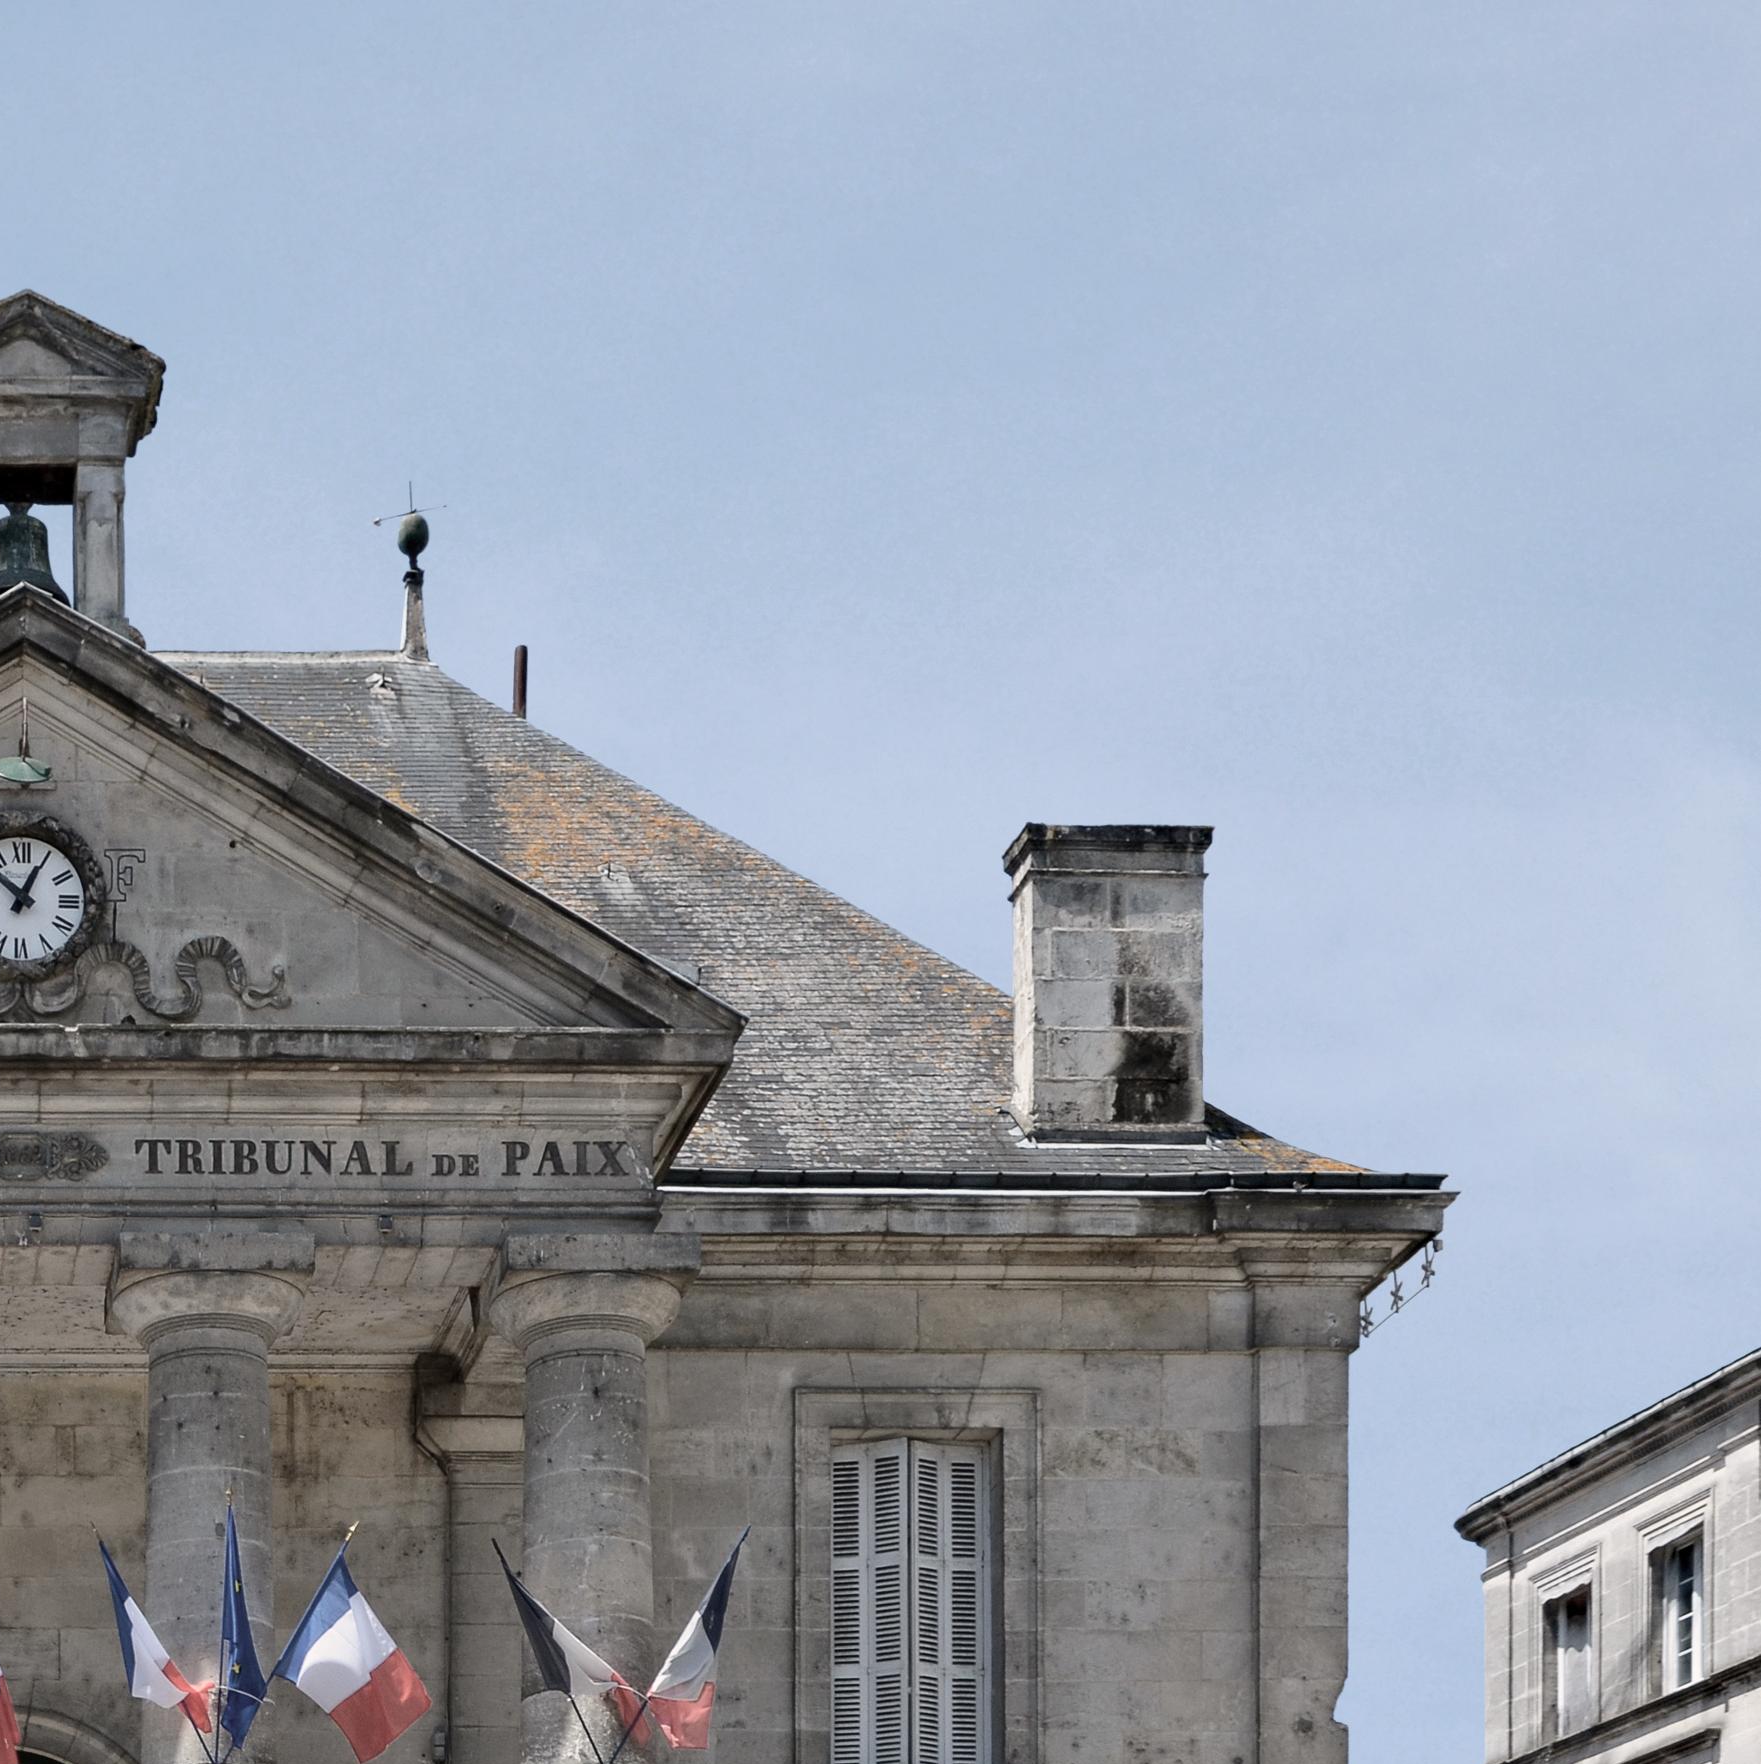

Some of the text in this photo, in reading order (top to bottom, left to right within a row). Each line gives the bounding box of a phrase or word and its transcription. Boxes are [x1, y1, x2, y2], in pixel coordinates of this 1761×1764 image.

[12, 841, 31, 863] XII
[51, 869, 74, 886] II
[103, 849, 146, 902] F
[58, 894, 80, 909] III
[14, 937, 28, 959] VI
[134, 1138, 630, 1177] TRIBUNAL DE PAIX
